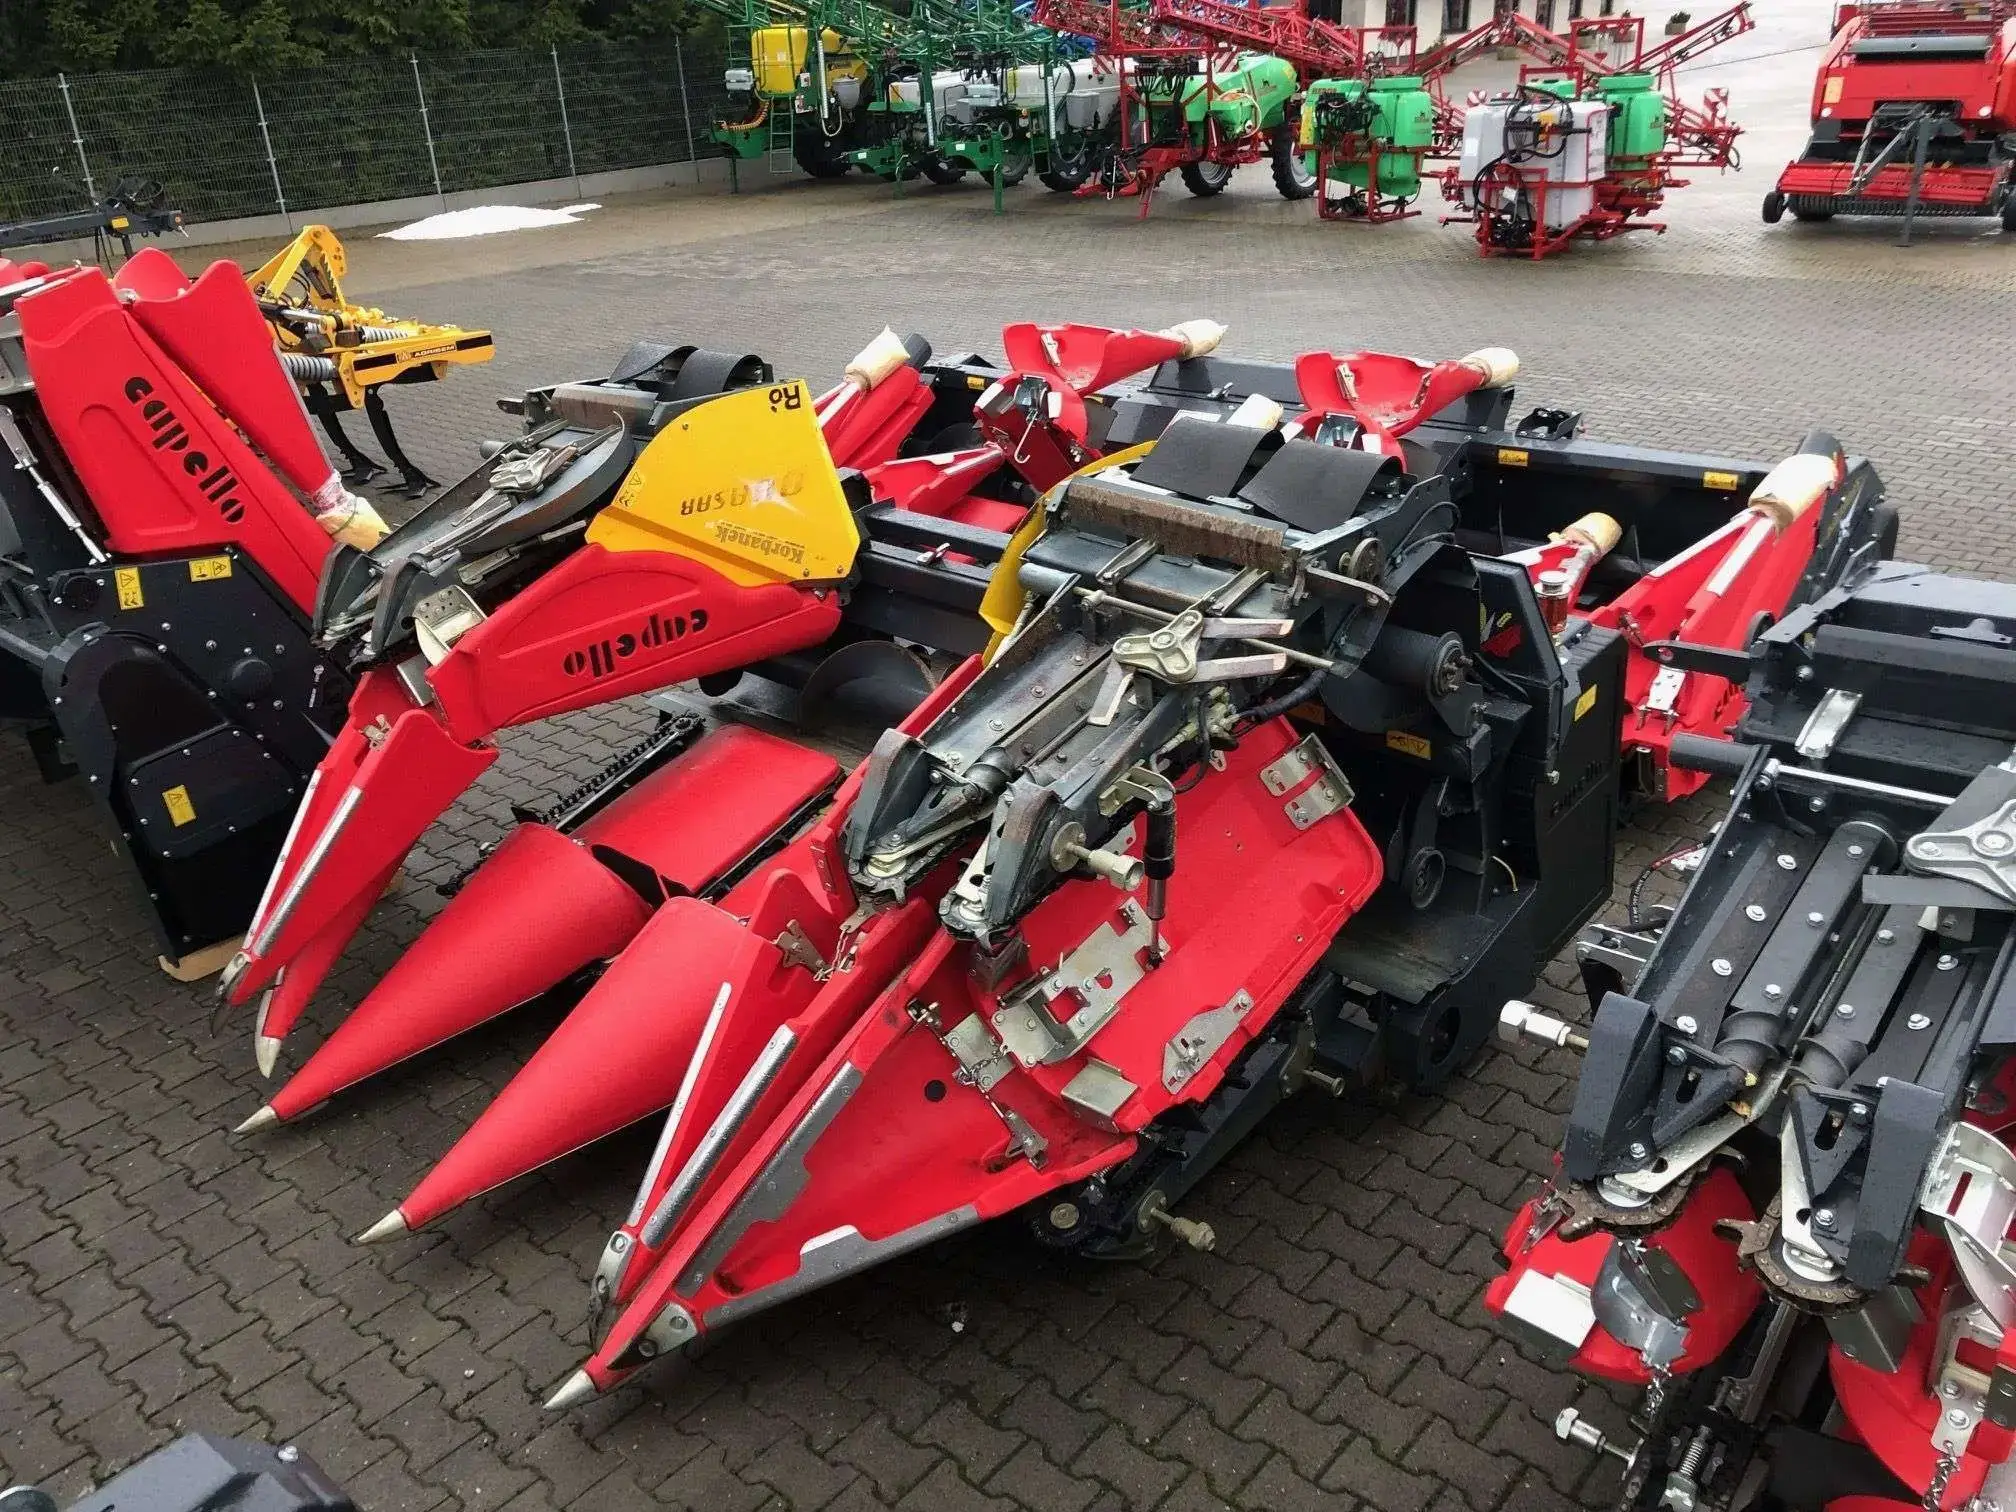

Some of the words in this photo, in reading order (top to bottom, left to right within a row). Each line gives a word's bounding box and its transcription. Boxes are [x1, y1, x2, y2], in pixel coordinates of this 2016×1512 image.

[125, 376, 245, 523] capello
[715, 525, 805, 565] Korbanek
[563, 608, 709, 678] capello
